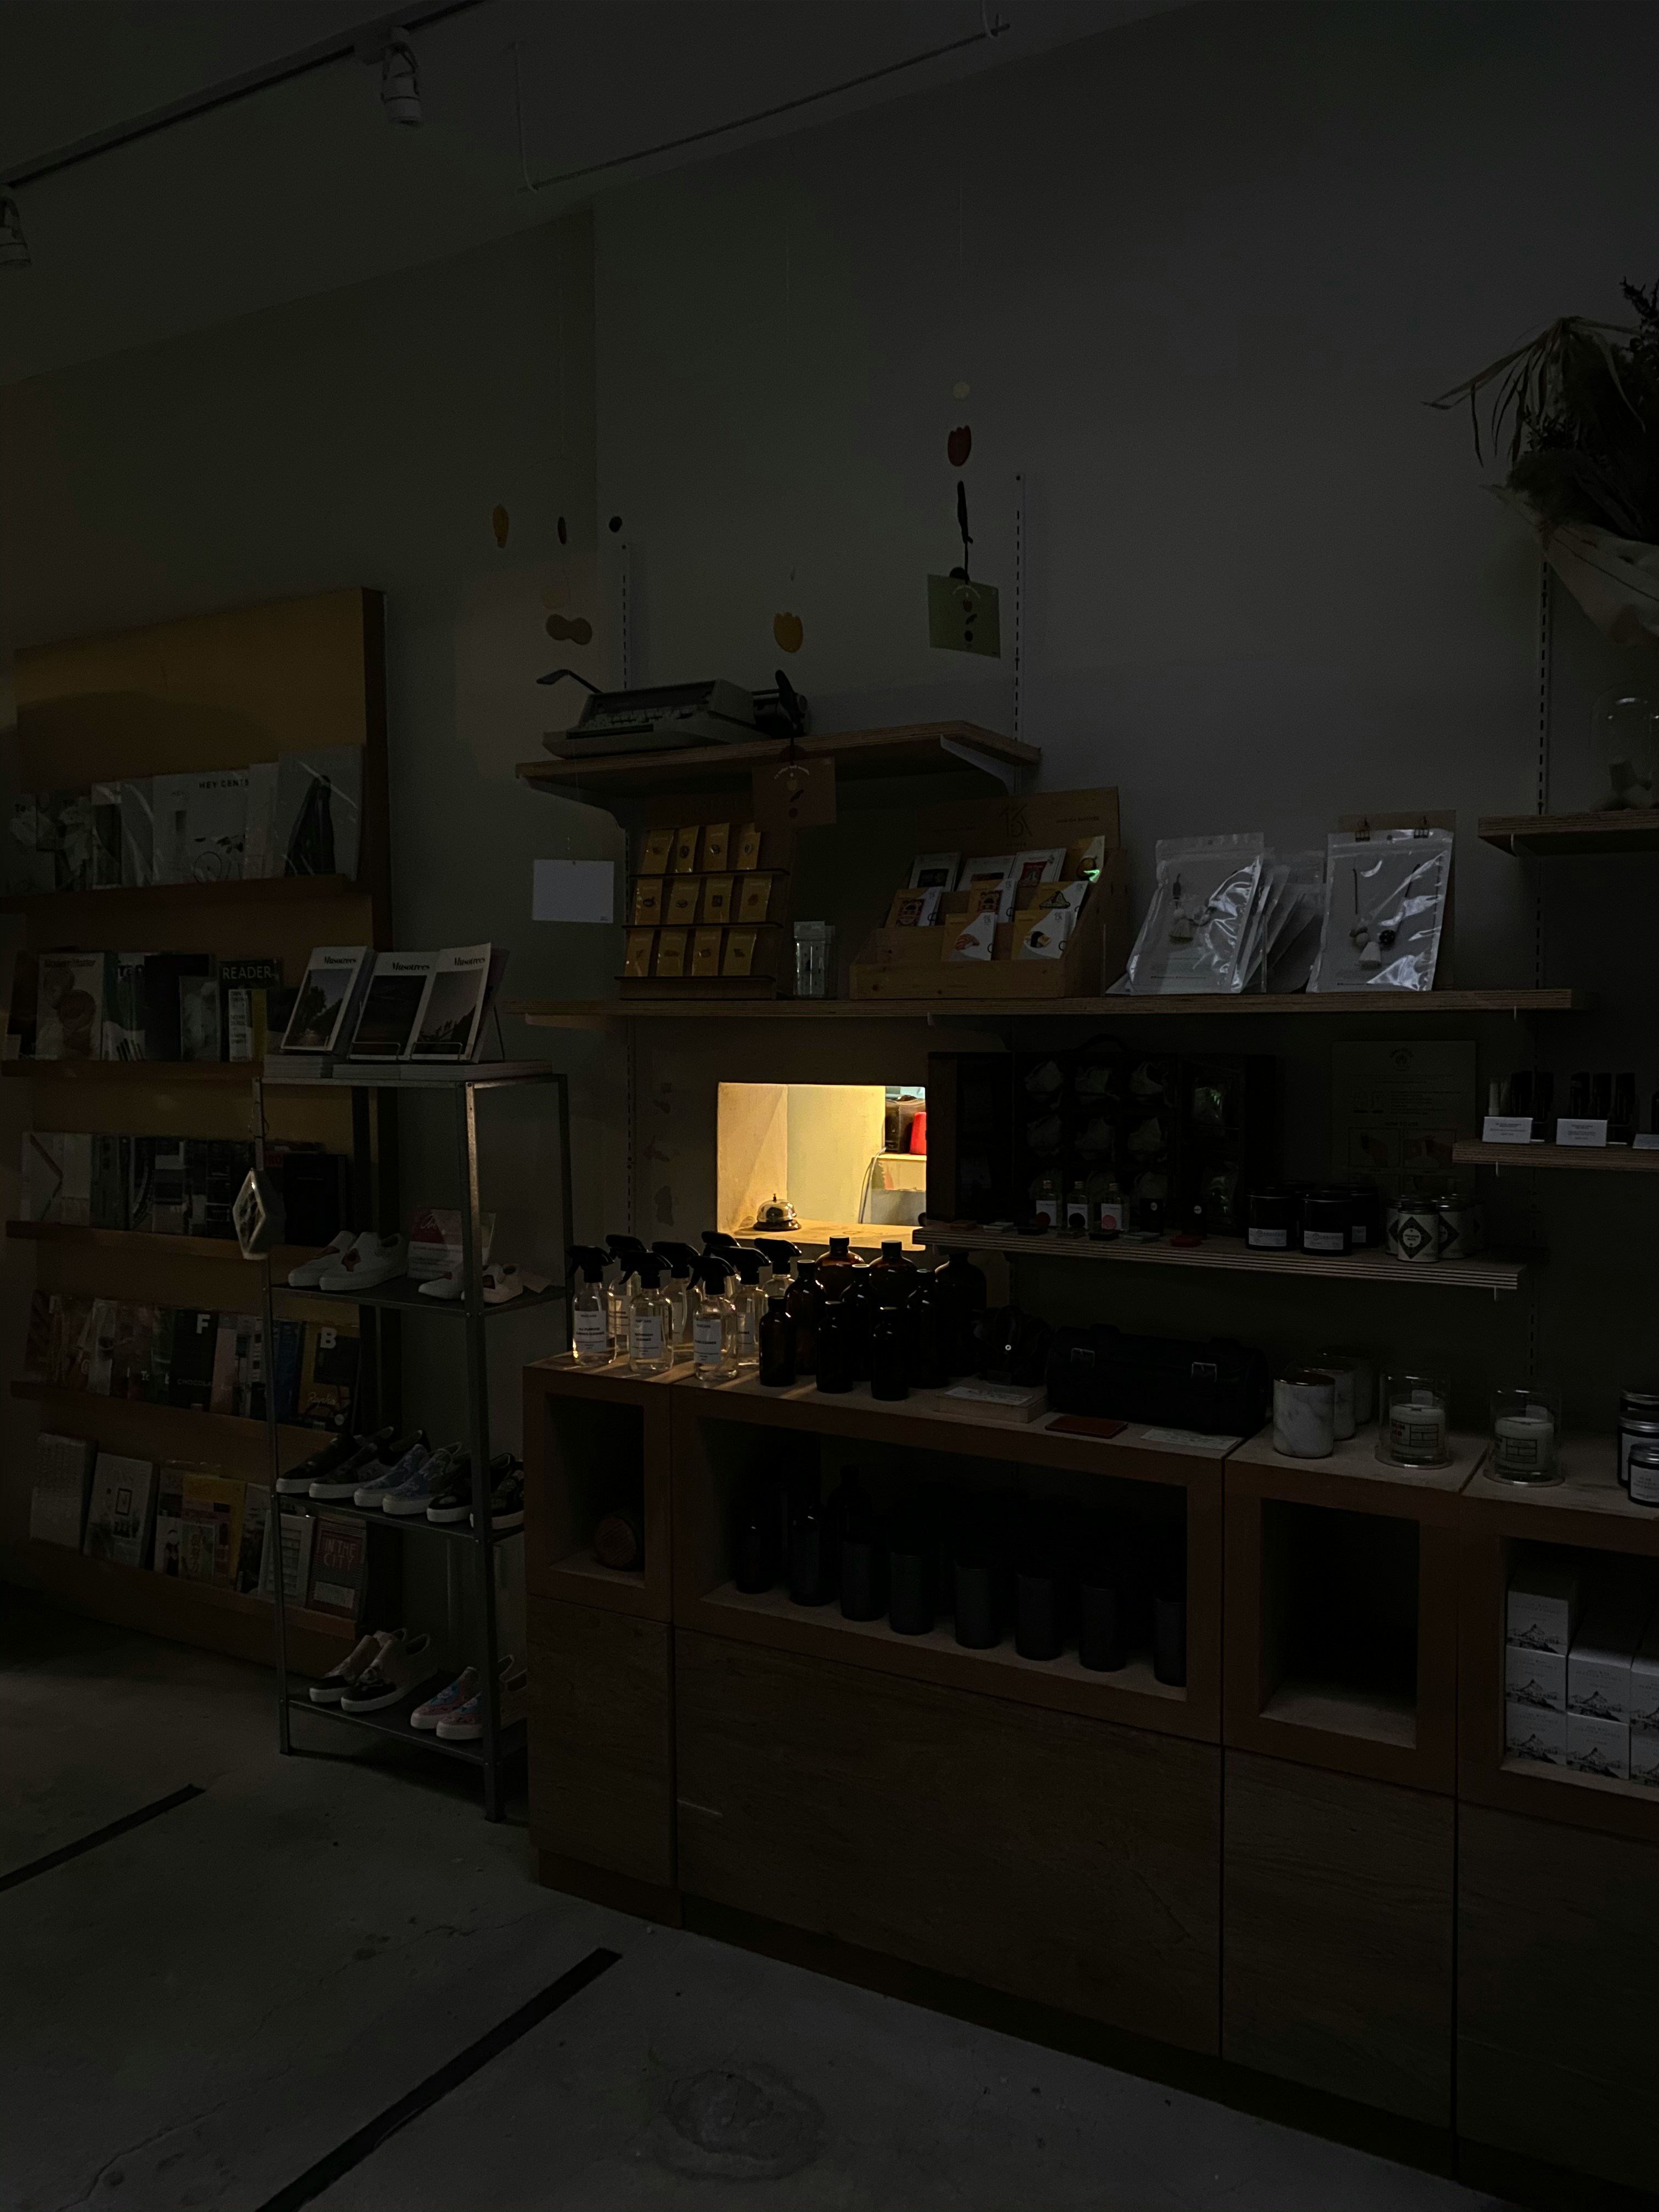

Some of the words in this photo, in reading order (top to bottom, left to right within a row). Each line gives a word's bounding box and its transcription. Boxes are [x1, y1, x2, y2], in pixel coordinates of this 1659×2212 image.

[199, 781, 218, 789] HEY
[222, 965, 272, 980] READER
[195, 1313, 211, 1334] F
[319, 1326, 337, 1350] B
[325, 1537, 335, 1554] IN
[336, 1539, 357, 1558] THE
[323, 1552, 356, 1572] CITY
